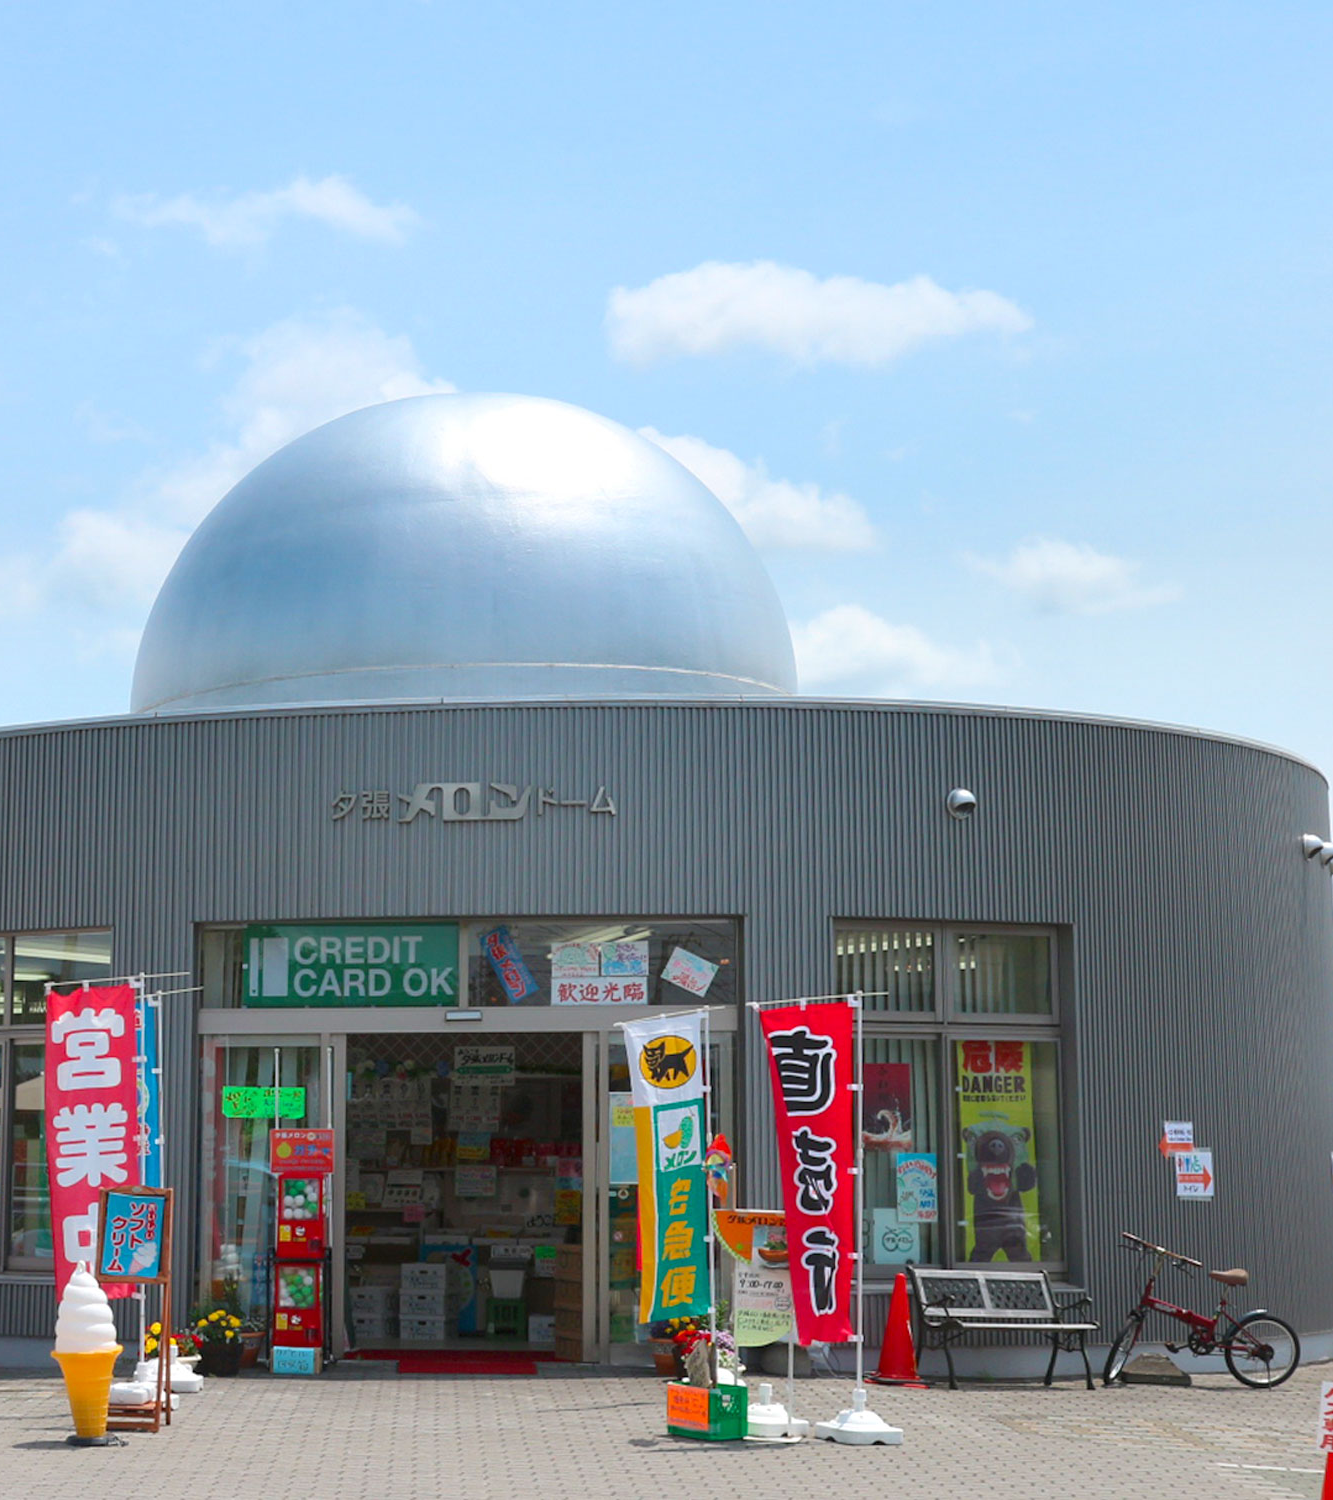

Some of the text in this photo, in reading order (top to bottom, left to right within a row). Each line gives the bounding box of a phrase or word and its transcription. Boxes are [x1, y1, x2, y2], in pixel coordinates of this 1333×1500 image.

[294, 936, 423, 965] CREDIT
[294, 967, 455, 997] CARD OK
[962, 1075, 1026, 1094] DANGER
[664, 1150, 697, 1171] メロン
[129, 1202, 147, 1249] ソフト
[106, 1216, 129, 1273] クリーム
[660, 1177, 697, 1308] 宅急便
